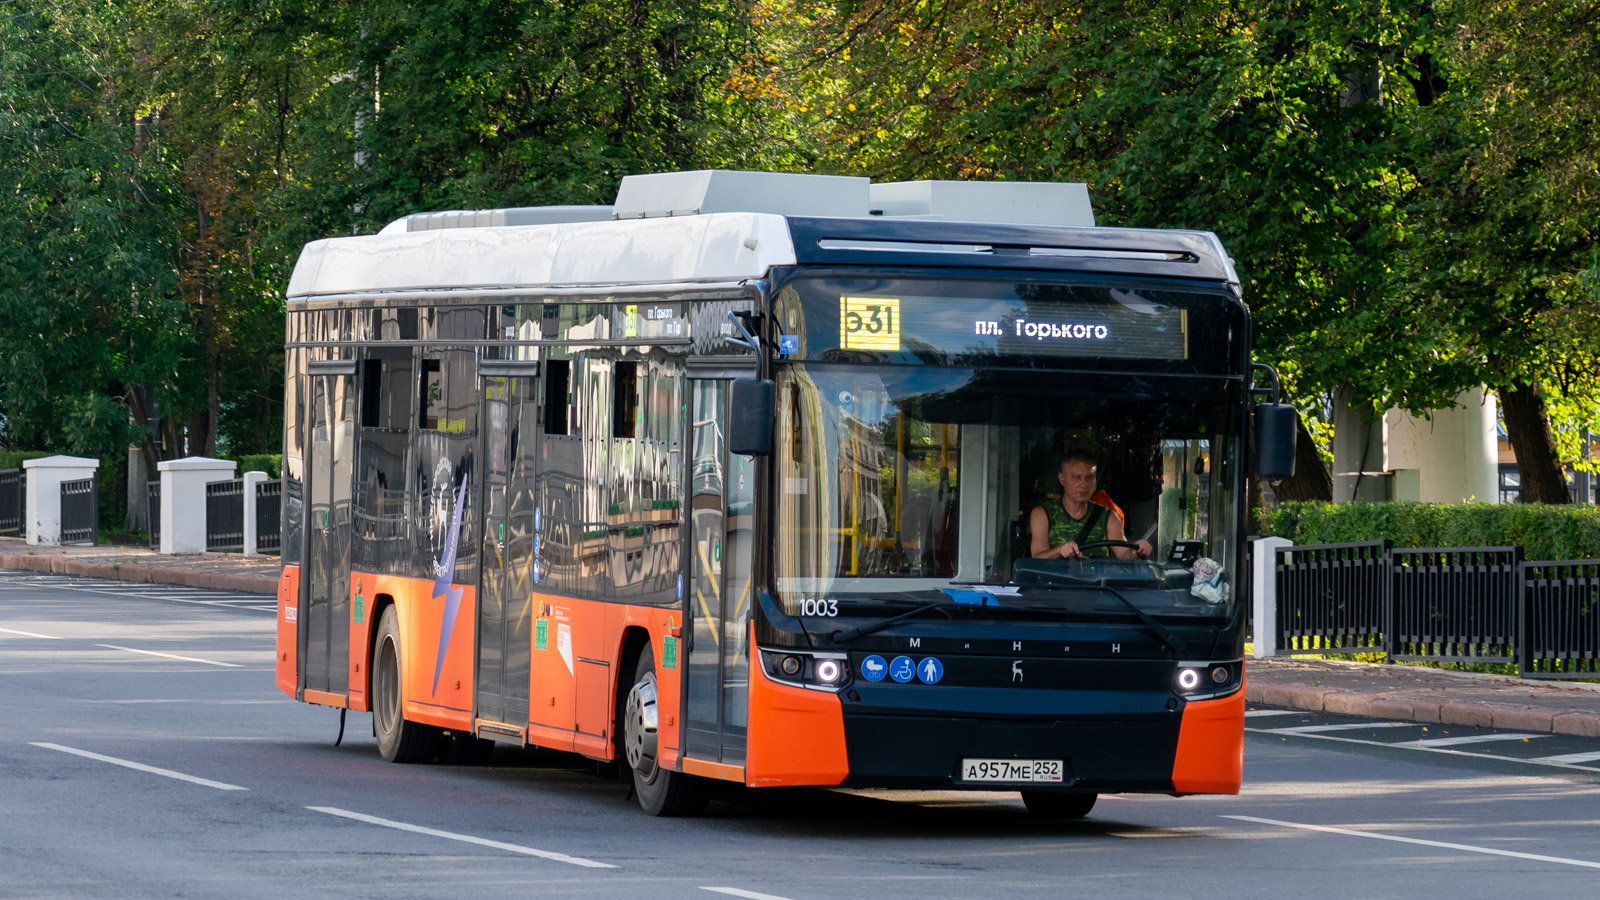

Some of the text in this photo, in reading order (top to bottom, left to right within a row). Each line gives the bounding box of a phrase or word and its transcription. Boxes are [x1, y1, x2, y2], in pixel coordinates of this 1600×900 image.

[975, 318, 1108, 341] пл. Горького
[799, 598, 839, 618] 1003
[1034, 761, 1059, 775] 252
